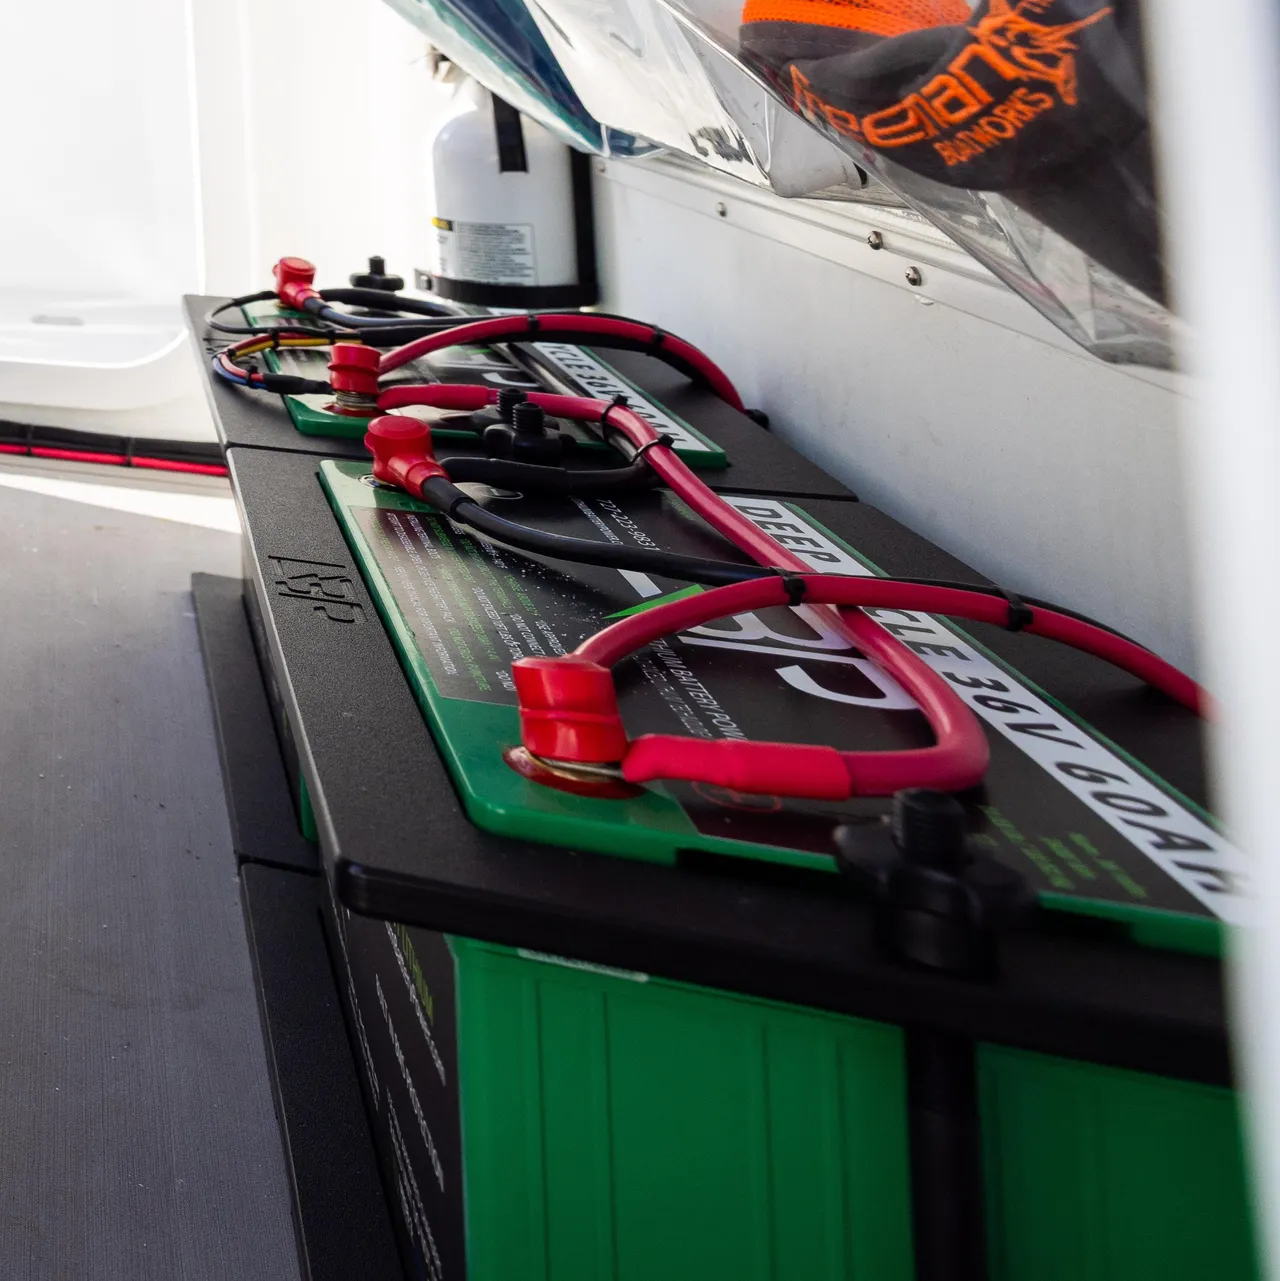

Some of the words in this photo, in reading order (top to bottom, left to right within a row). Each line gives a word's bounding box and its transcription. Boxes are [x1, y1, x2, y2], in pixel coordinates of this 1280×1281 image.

[597, 499, 660, 550] 727-223-9831
[735, 504, 841, 565] DEEP
[944, 670, 1086, 750] 36V
[670, 669, 724, 712] BATTERY
